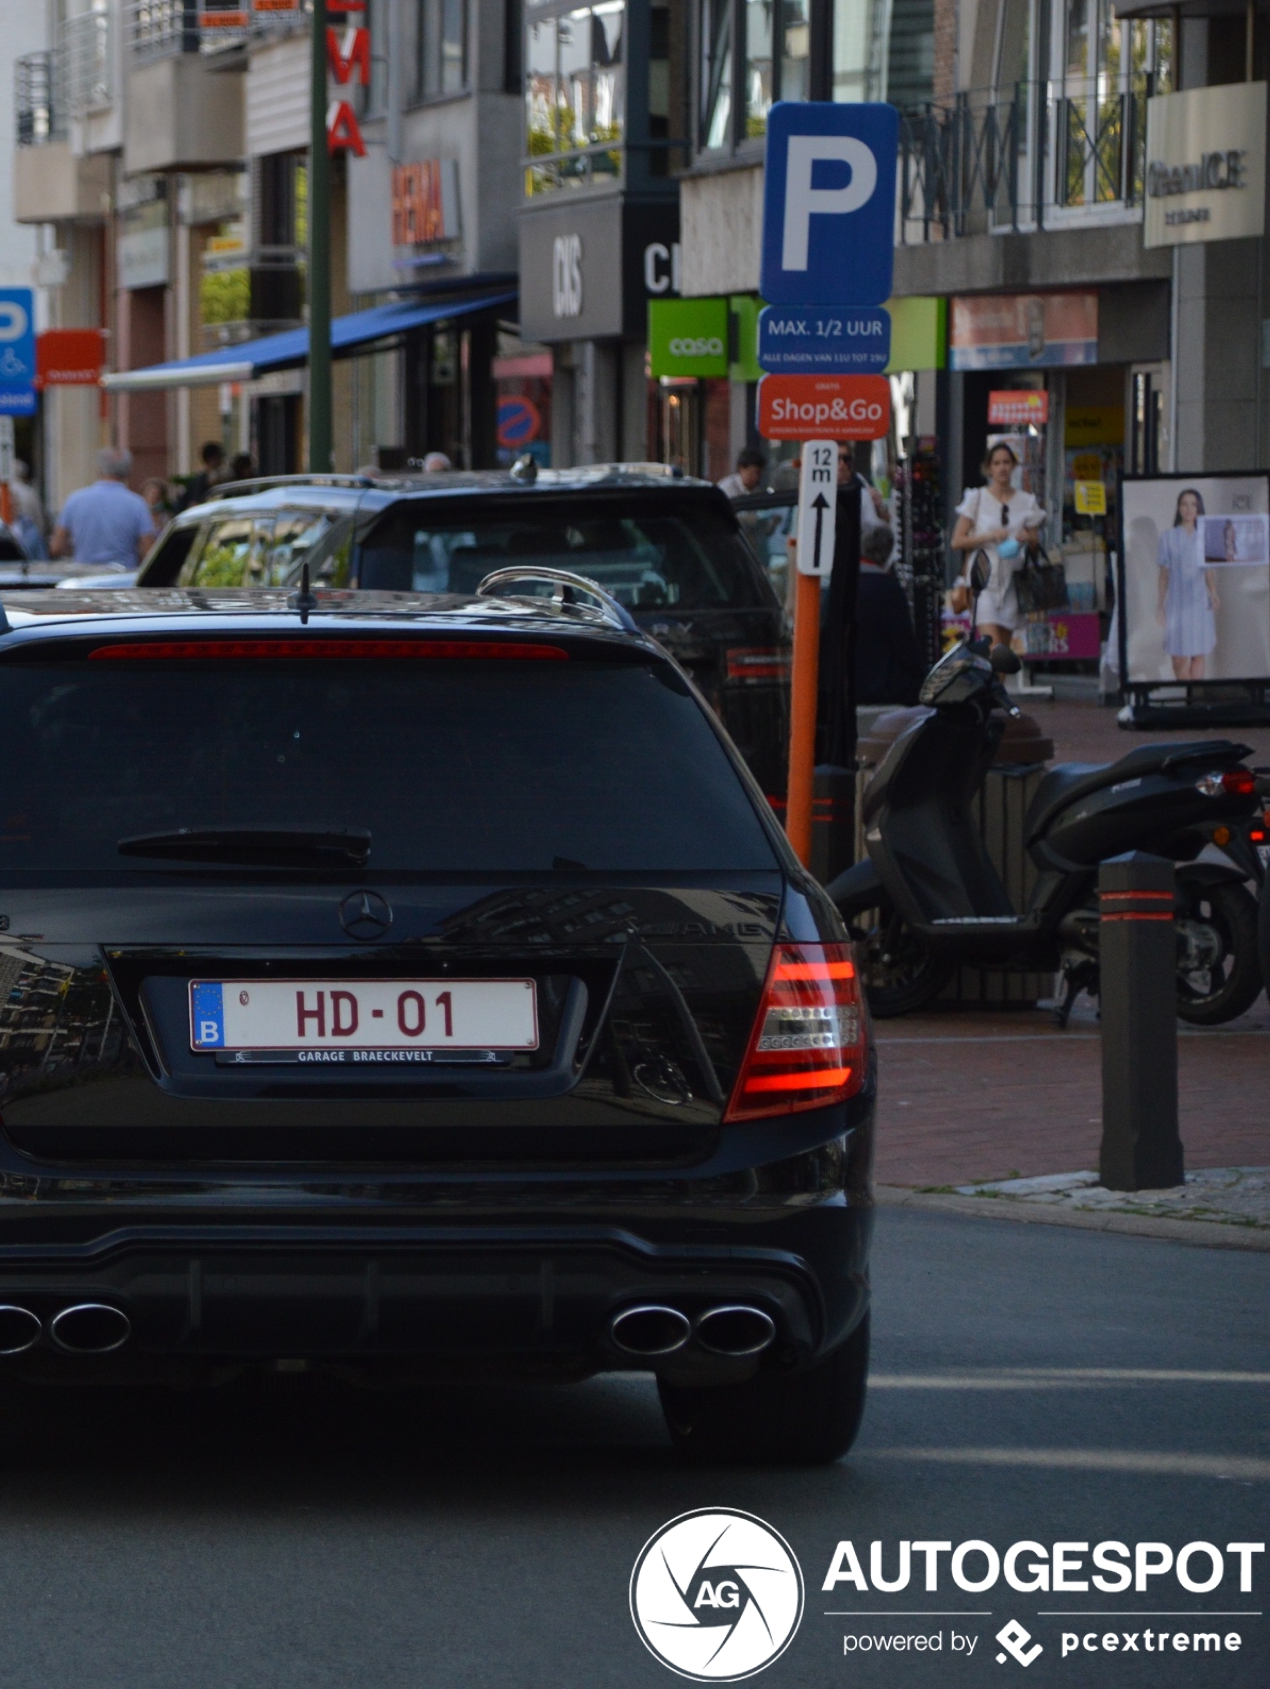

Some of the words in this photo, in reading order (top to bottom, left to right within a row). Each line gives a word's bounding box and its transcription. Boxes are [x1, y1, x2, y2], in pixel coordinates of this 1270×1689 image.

[782, 135, 878, 272] P
[552, 234, 581, 318] CKS
[768, 319, 811, 336] MAX.
[815, 319, 842, 338] 1/2
[846, 320, 883, 336] UUR
[668, 337, 724, 357] casa
[813, 353, 833, 362] VAN
[771, 397, 883, 425] Shop&Go
[812, 448, 833, 466] 12
[811, 468, 832, 482] m
[296, 989, 454, 1038] HD-01
[200, 1020, 220, 1043] B
[298, 1051, 345, 1062] GARAGE
[353, 1051, 434, 1062] BRAECKEVELT
